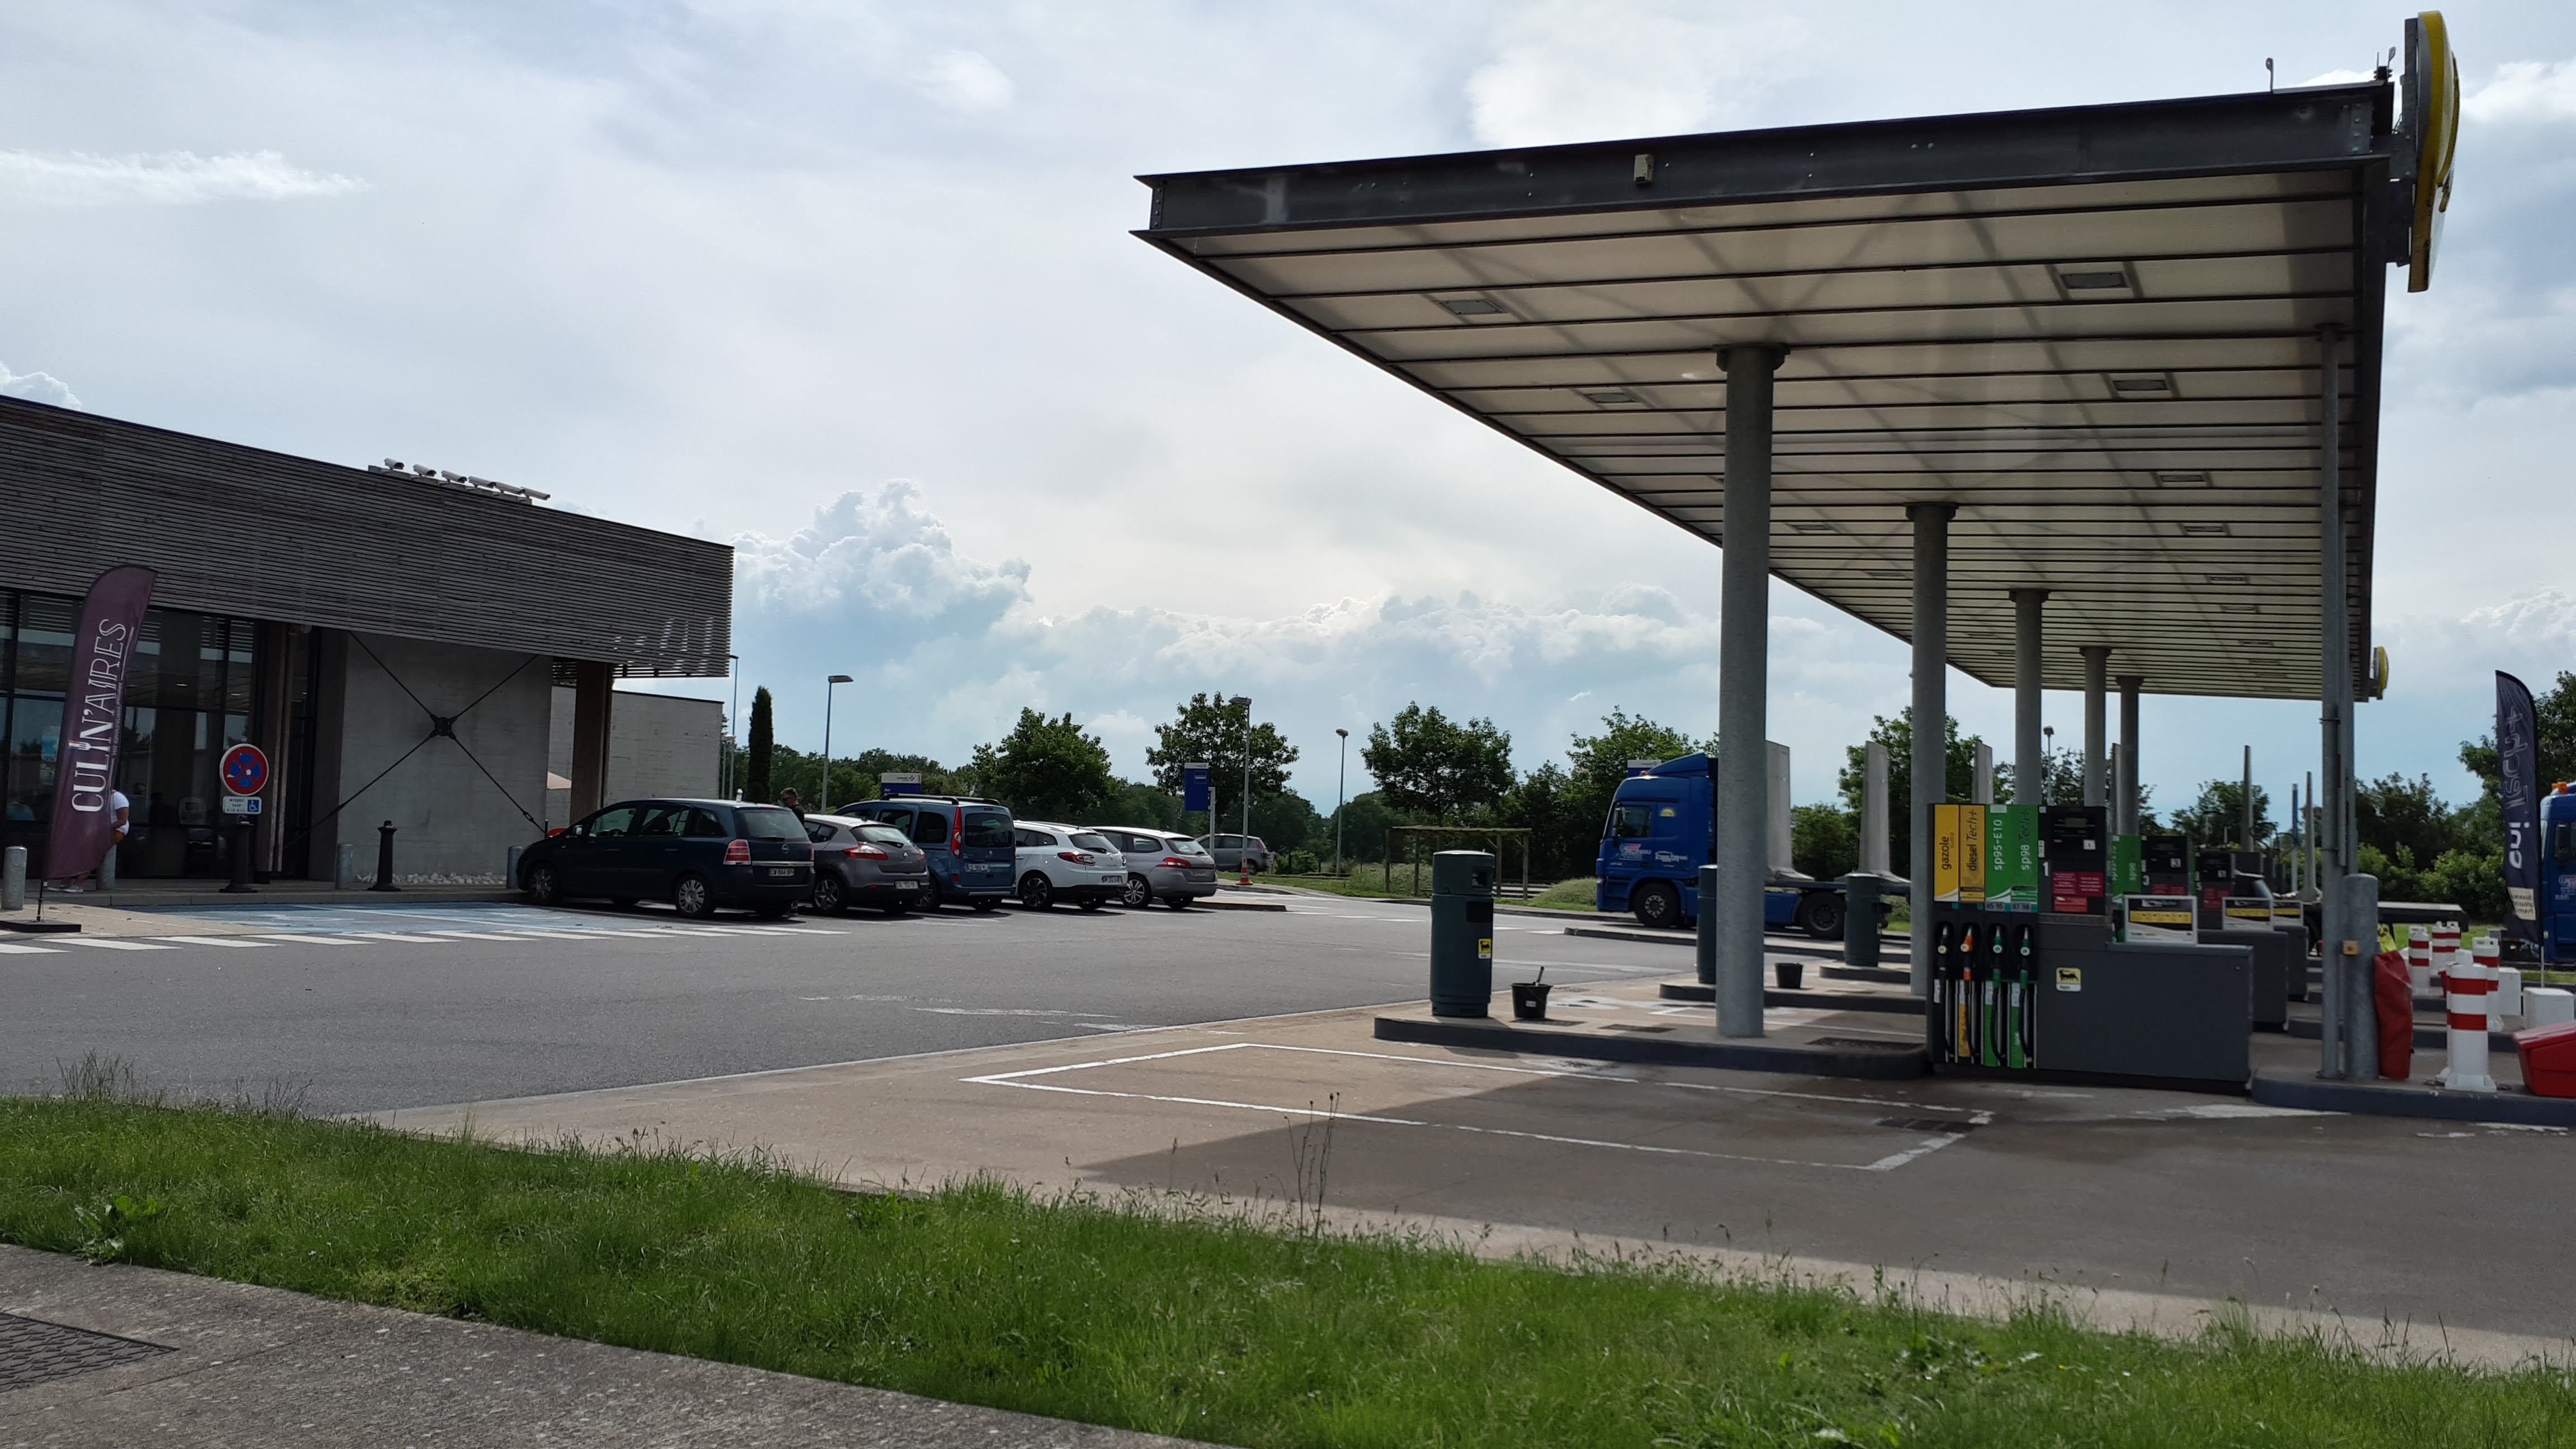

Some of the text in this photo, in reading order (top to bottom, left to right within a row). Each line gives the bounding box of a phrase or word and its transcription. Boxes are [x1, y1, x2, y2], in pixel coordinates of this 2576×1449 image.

[69, 619, 126, 812] CULIN'AIRES
[1939, 836, 1952, 870] gazole
[1966, 809, 1978, 871] diesel Tech+
[1993, 819, 2005, 870] sp95-E10
[2019, 810, 2033, 870] sp98 Tech+
[2043, 861, 2049, 877] 1
[2142, 875, 2150, 886] 3
